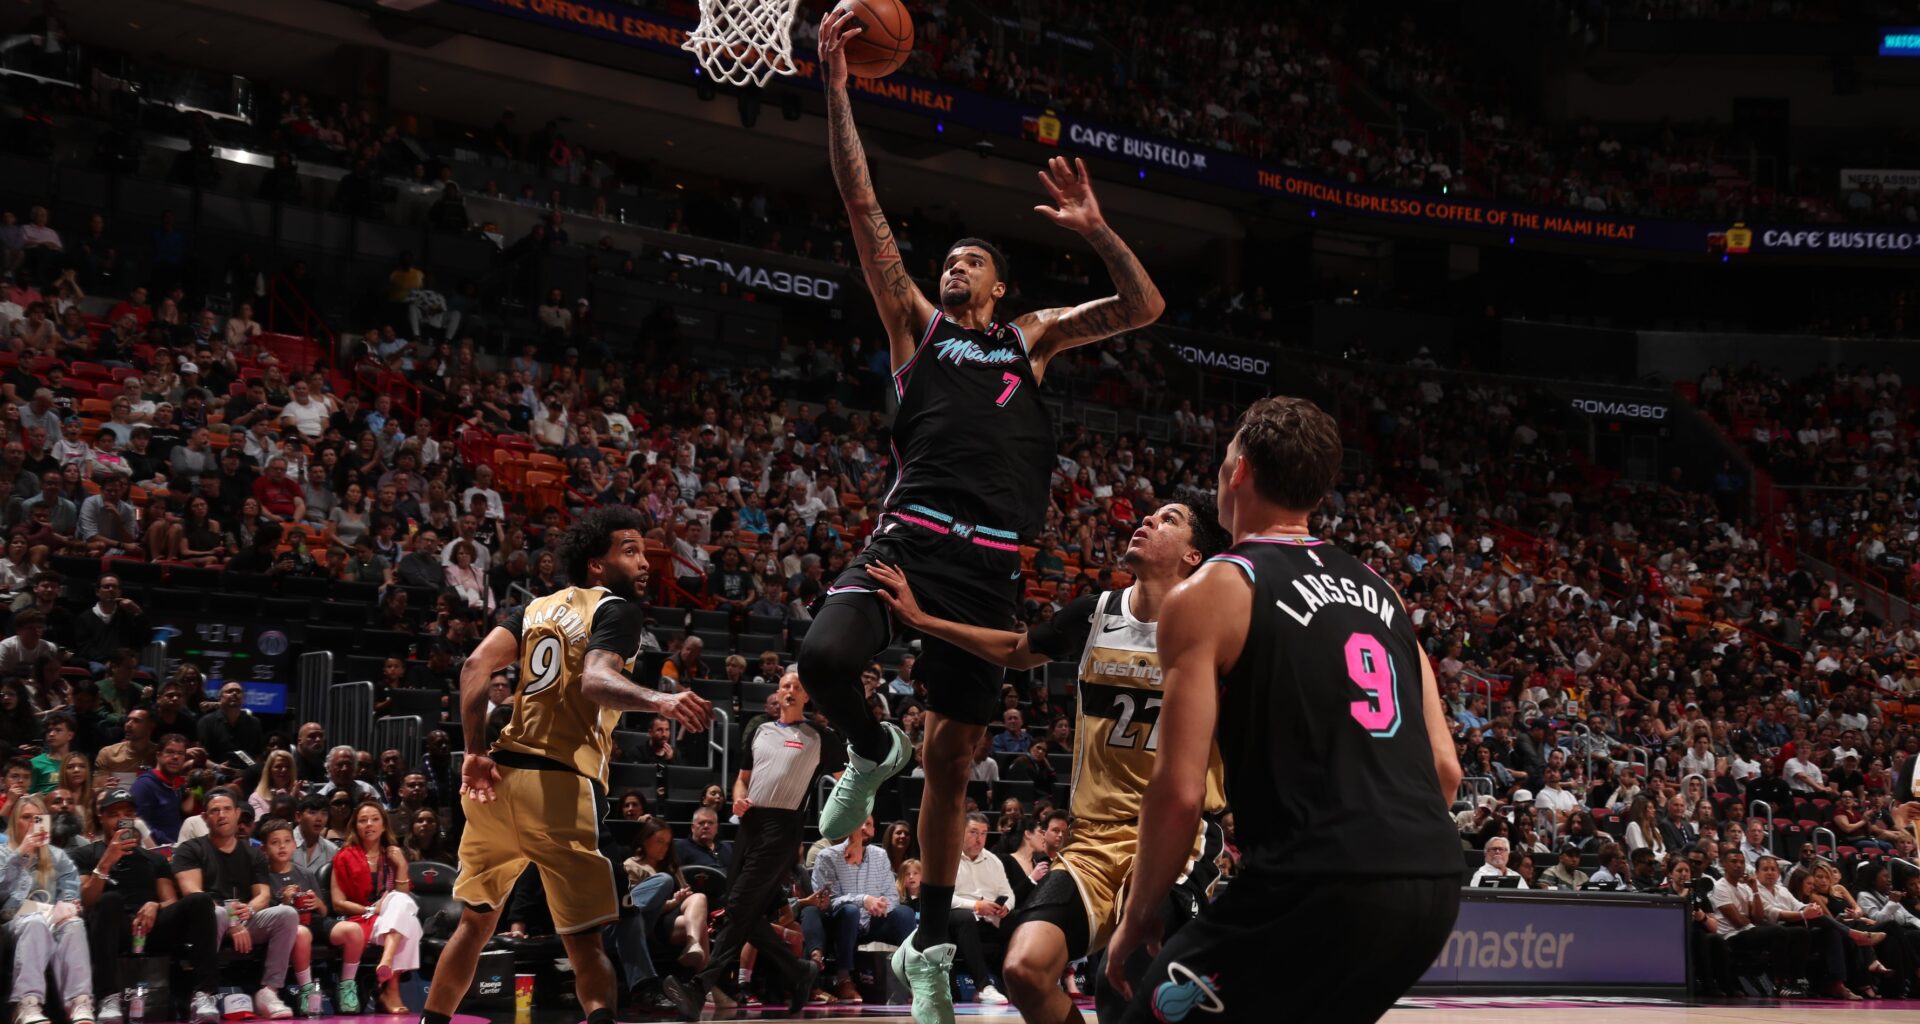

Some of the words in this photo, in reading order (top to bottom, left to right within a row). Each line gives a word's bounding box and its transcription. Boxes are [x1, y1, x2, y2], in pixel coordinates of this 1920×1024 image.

[911, 86, 953, 113] HEAT
[1122, 136, 1191, 169] BUSTELO
[1883, 174, 1920, 185] ASSIS
[1256, 169, 1282, 190] THE
[1285, 177, 1343, 205] OFFICIAL
[1345, 191, 1422, 217] ESPRESSO
[1424, 202, 1483, 224] COFFEE
[1486, 209, 1508, 225] OF
[1510, 212, 1540, 230] THE
[1543, 216, 1592, 235] MIAMI
[1595, 222, 1637, 240] HEAT
[1827, 230, 1913, 250] BUSTELO
[933, 337, 1024, 367] Miami
[994, 370, 1023, 408] 7
[1276, 573, 1395, 628] LARSSON
[523, 635, 562, 695] 9
[1344, 631, 1402, 738] 9
[1106, 692, 1163, 752] 27
[1431, 922, 1574, 969] master
